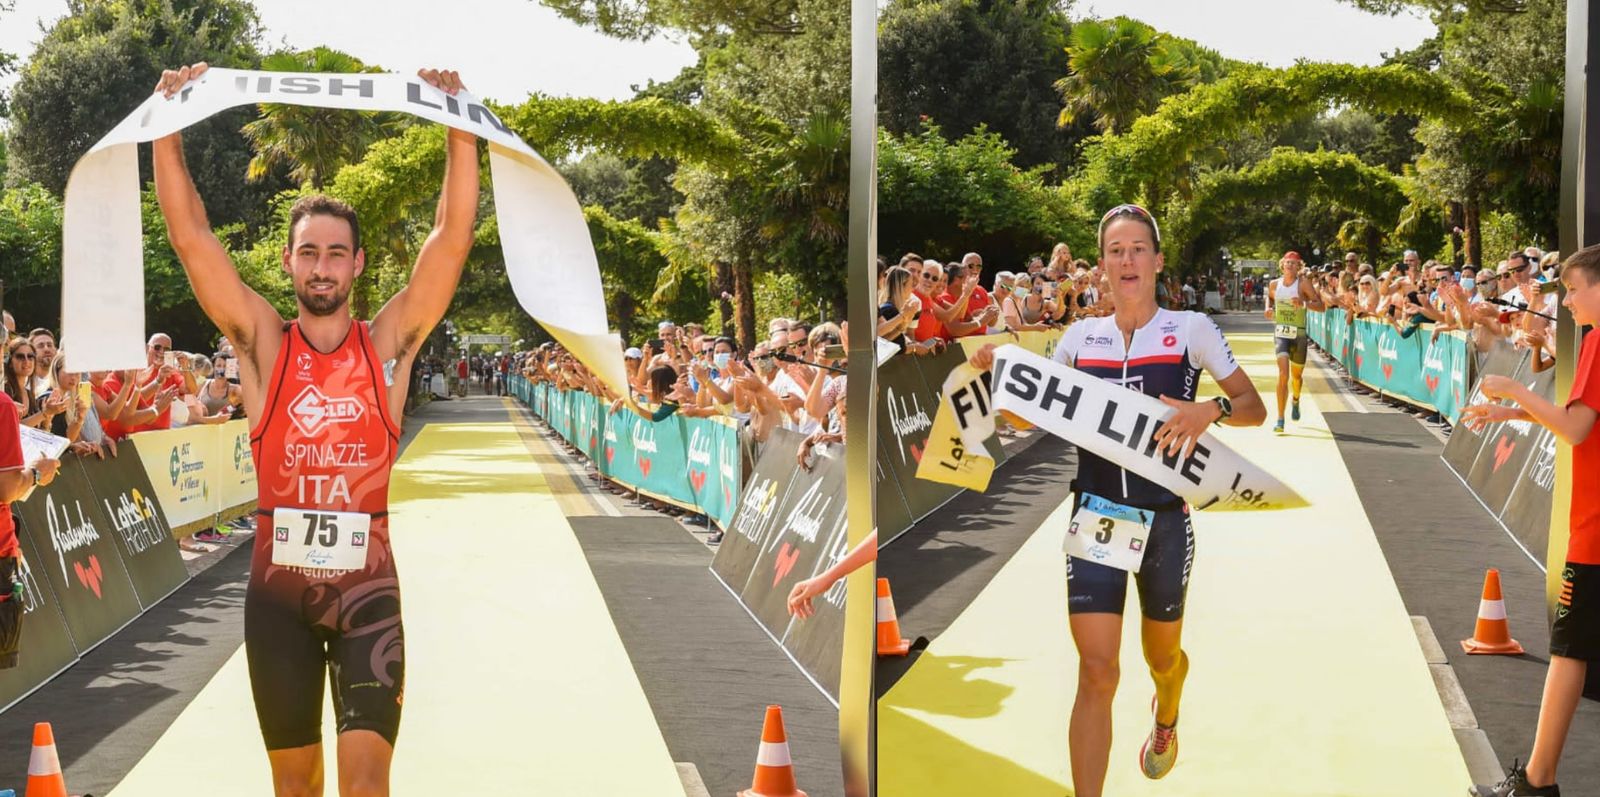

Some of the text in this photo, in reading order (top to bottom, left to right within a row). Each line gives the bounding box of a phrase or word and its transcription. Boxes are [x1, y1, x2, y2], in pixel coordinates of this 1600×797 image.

[284, 438, 368, 467] SPINAZZÈ
[298, 475, 351, 504] ITA
[302, 513, 338, 548] 75
[1095, 517, 1115, 544] 3
